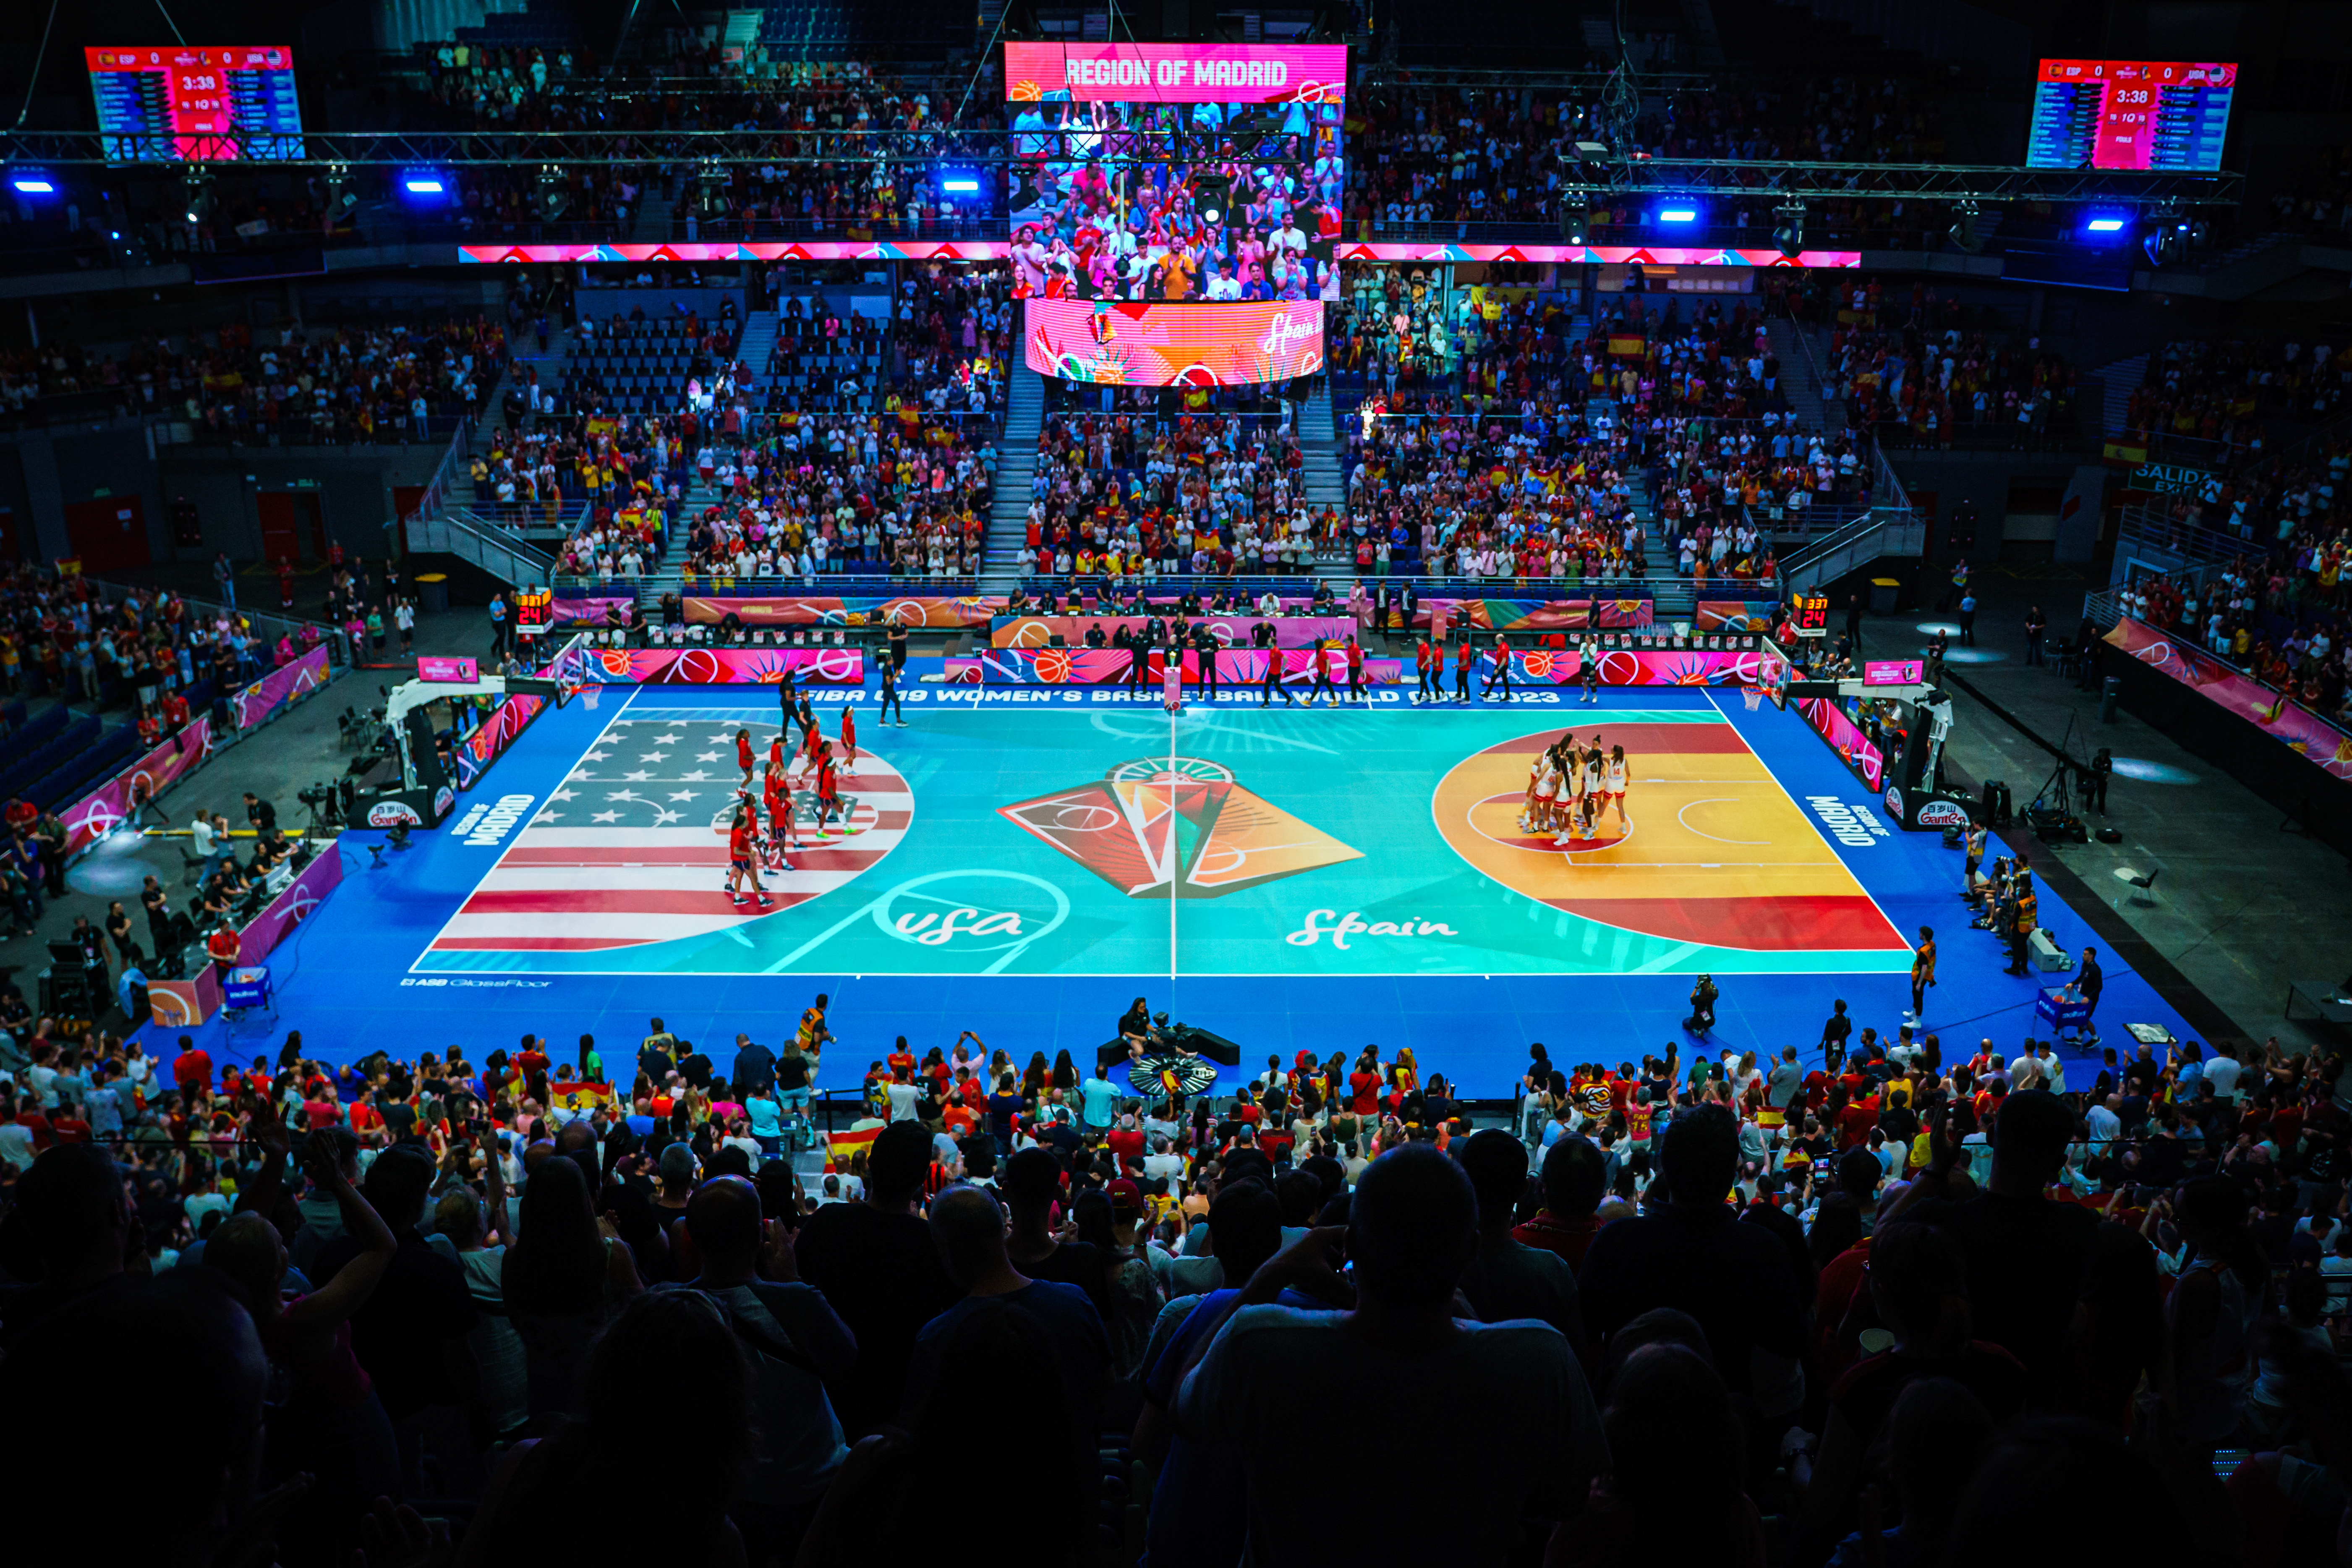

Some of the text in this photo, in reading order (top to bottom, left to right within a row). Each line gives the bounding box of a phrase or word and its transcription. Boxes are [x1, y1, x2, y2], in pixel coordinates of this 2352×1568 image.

[150, 52, 160, 64] 0
[222, 51, 232, 64] 0
[1065, 59, 1288, 87] REGION OF MADRID
[2094, 65, 2103, 76] 0
[2164, 67, 2172, 79] 0
[2188, 70, 2206, 79] USA
[182, 75, 216, 91] 3:38
[2117, 89, 2148, 104] 3:38
[1263, 312, 1315, 356] Spain
[519, 606, 540, 625] 24
[1802, 610, 1825, 628] 24
[936, 690, 1082, 702] WOMEN'S
[1091, 690, 1287, 703] BASKETBALL
[1291, 690, 1400, 703] WORLD
[1480, 691, 1560, 703] 2023
[1927, 804, 1956, 813] 百岁山
[463, 794, 535, 846] MADRID
[1805, 796, 1876, 846] MADRID
[1286, 908, 1459, 950] Spain
